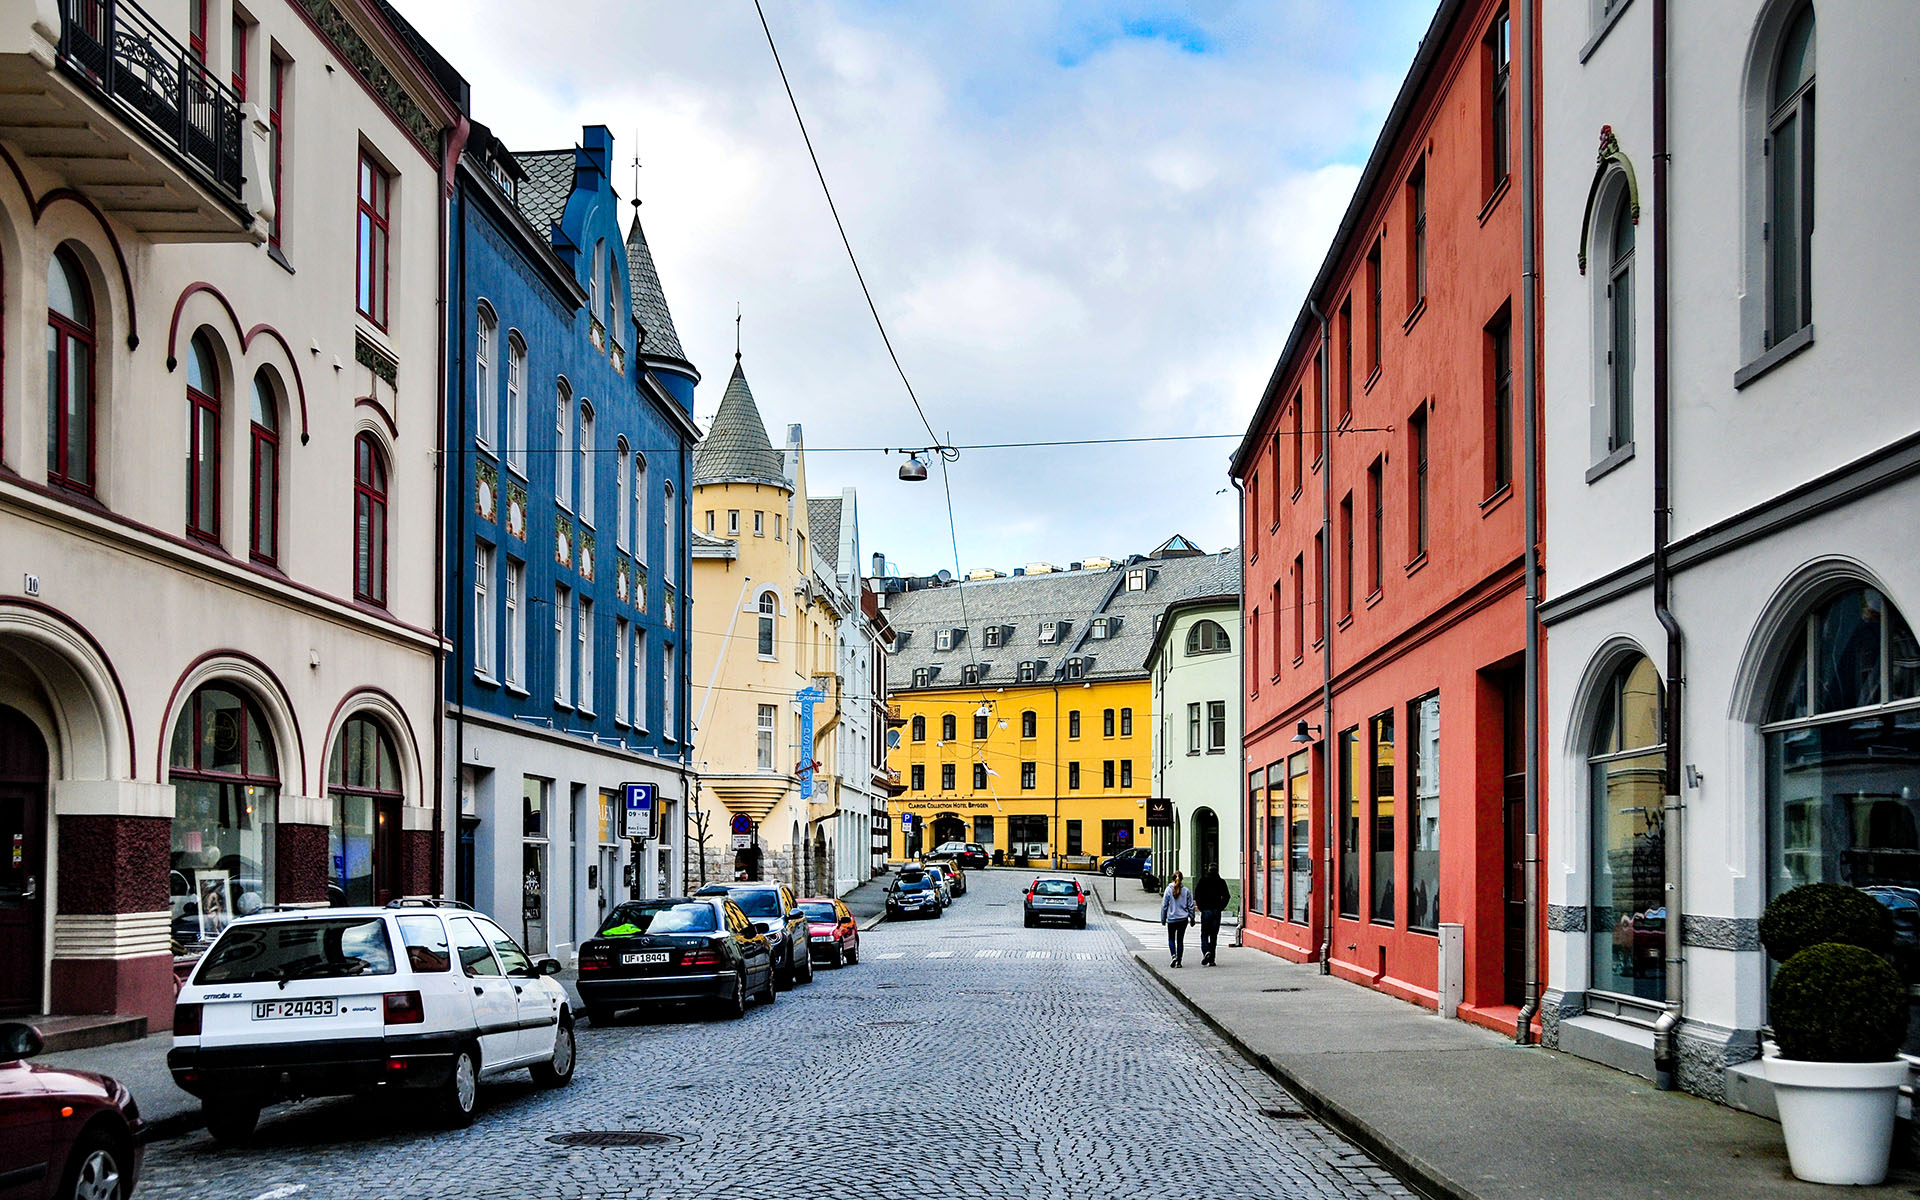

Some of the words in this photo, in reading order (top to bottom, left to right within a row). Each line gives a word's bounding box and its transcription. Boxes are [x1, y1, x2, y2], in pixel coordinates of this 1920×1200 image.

[28, 577, 38, 592] 10
[633, 788, 646, 807] P
[904, 814, 911, 822] P
[624, 955, 635, 963] UF
[256, 1003, 275, 1018] UF
[283, 1000, 334, 1017] 24433
